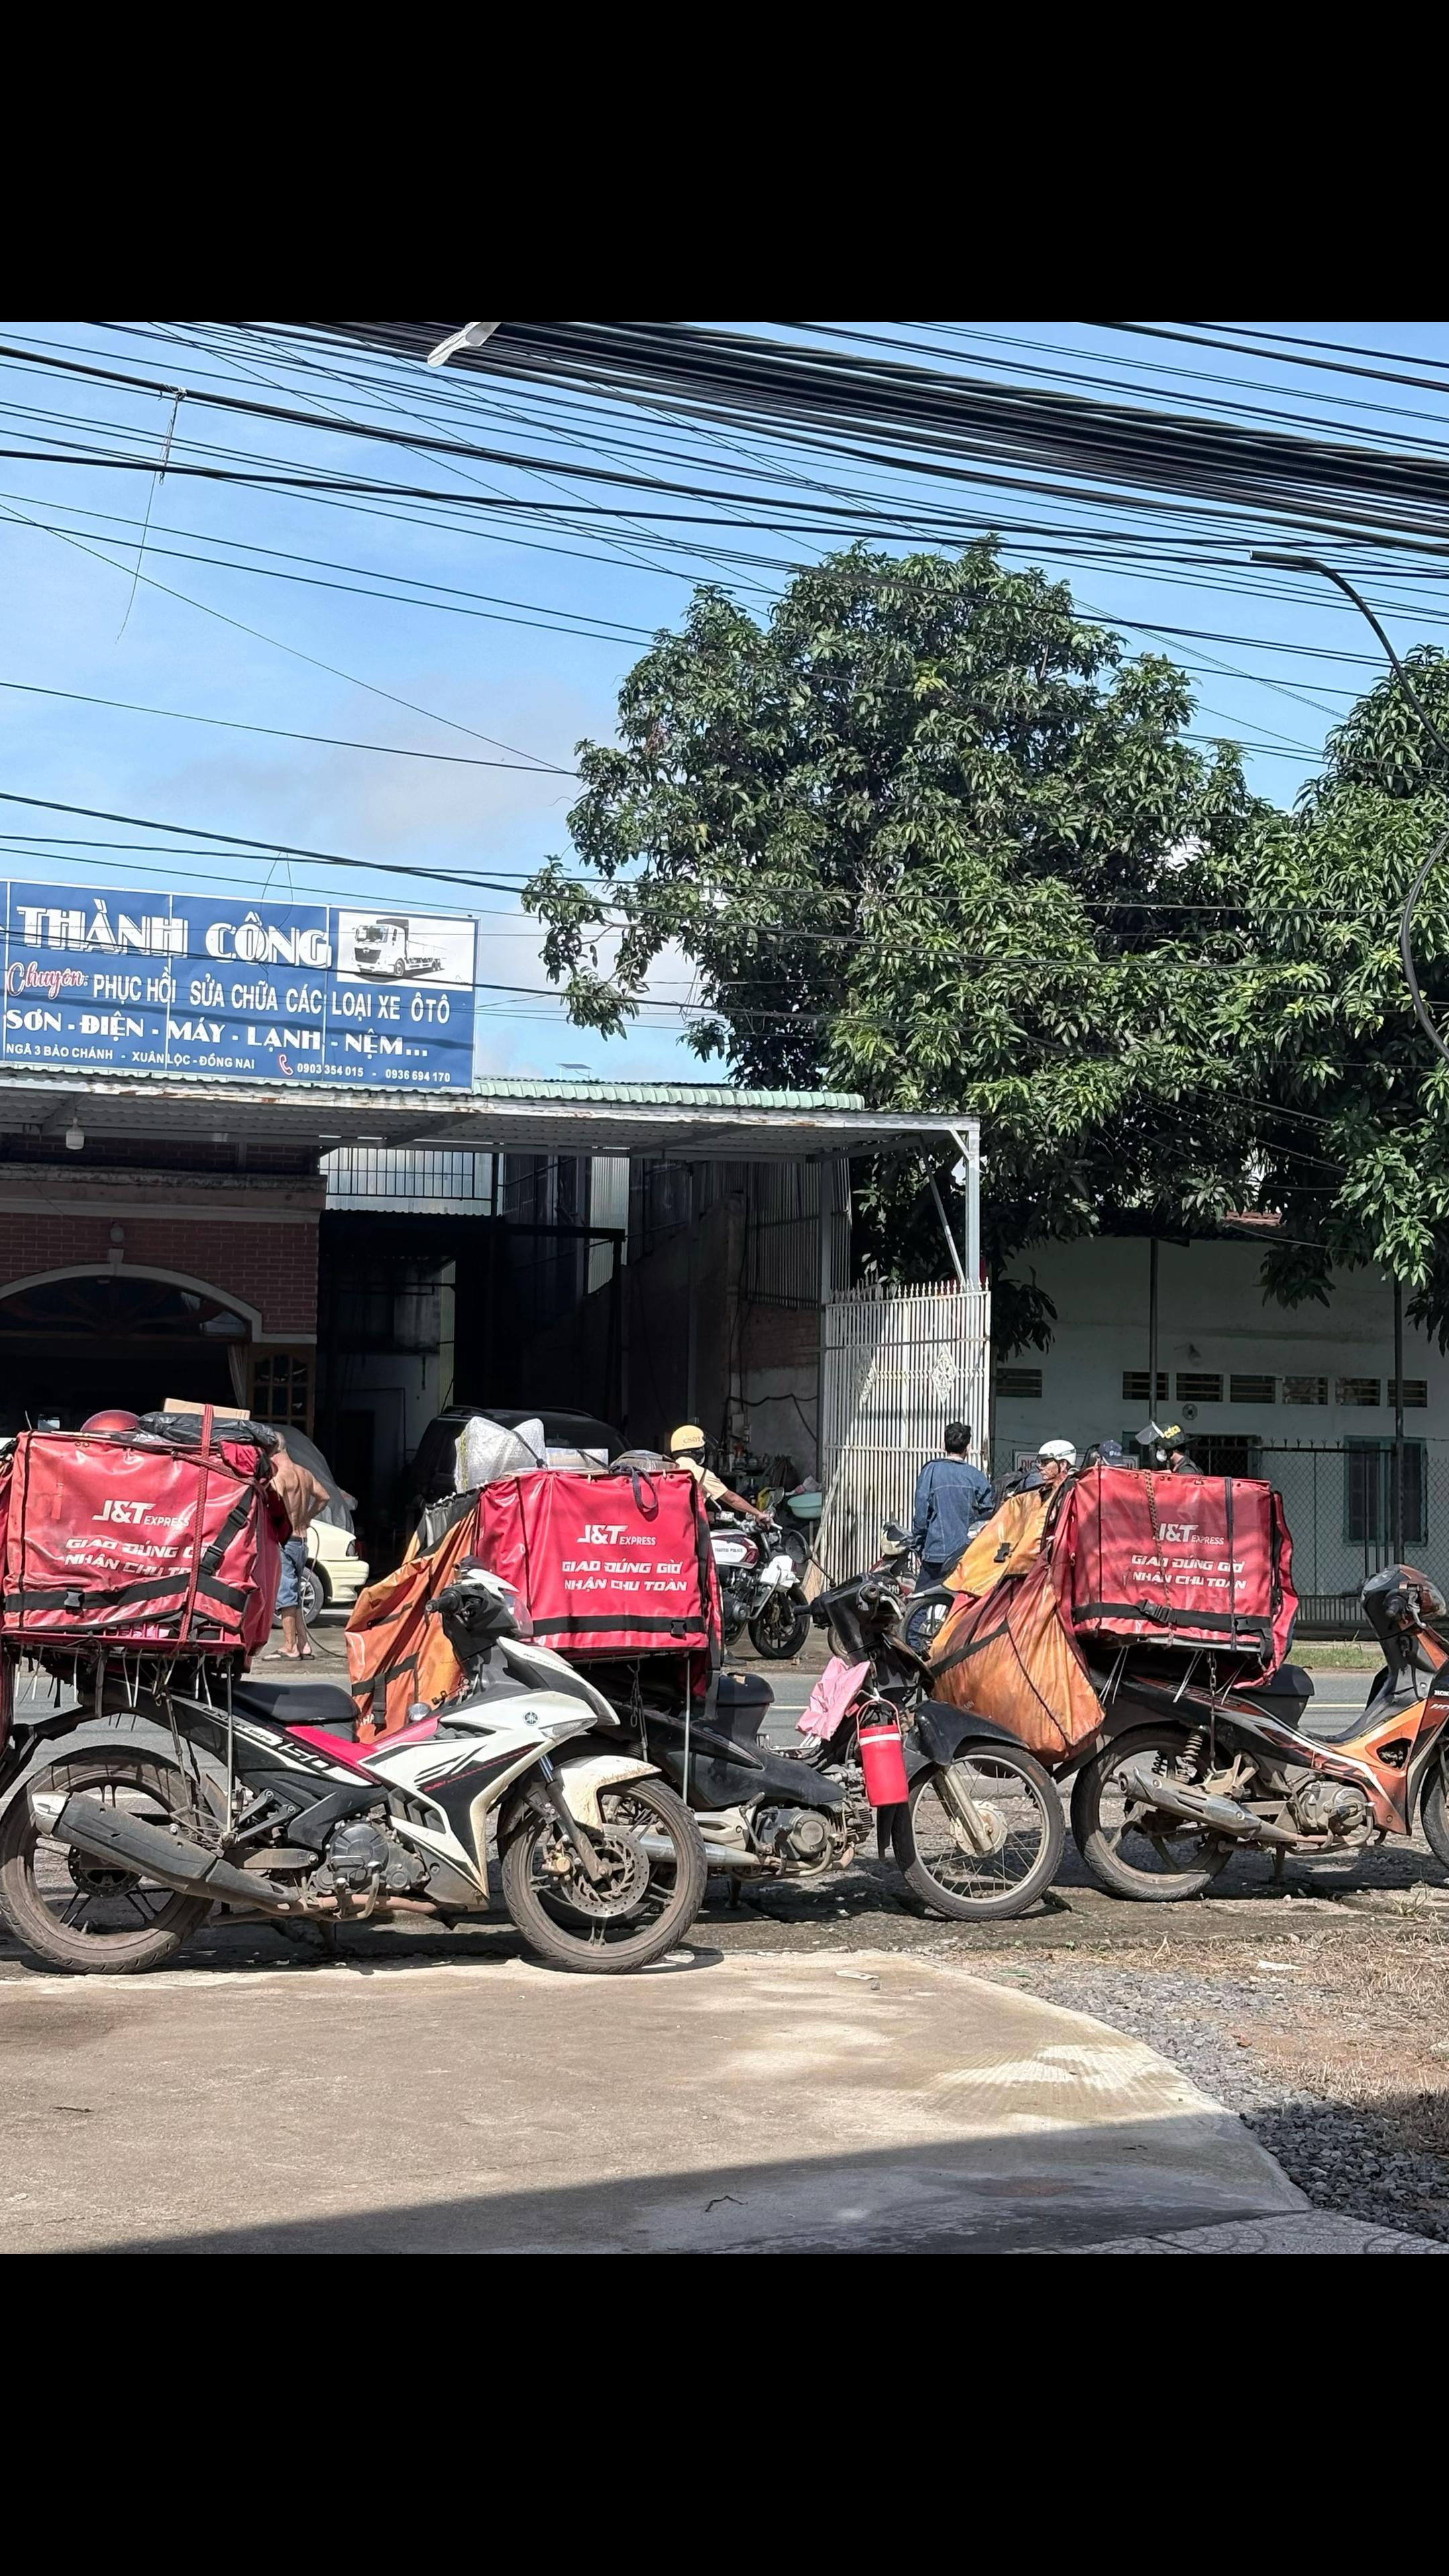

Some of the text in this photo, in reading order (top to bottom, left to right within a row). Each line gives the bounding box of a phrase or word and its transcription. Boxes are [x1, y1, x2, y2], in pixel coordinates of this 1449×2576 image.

[16, 898, 332, 969] THÀNH CÔNG
[93, 973, 142, 1004] PHỤC
[147, 966, 176, 1004] HỒI
[190, 973, 225, 1007] SỬA
[231, 980, 278, 1011] CHỮA
[286, 983, 322, 1014] CÁC
[332, 991, 372, 1022] LOẠI
[378, 995, 400, 1020] XE
[411, 991, 450, 1024] ÔTÔ
[6, 1008, 62, 1032] SƠN
[79, 1010, 144, 1042] ĐIỆN
[168, 1017, 225, 1042] MÁY
[248, 1026, 321, 1052] LẠNH
[34, 1045, 41, 1055] 3
[72, 1046, 113, 1059] CHÁNH
[131, 1051, 164, 1064] XUÂN
[235, 1058, 255, 1069] NAI
[297, 1063, 451, 1083] 0903 354 015 0936 694 170
[92, 1499, 189, 1526] J&T EXPRESS
[577, 1524, 656, 1546] J&T EXPRESS
[1152, 1523, 1224, 1545] J&T EXPRESS
[66, 1539, 117, 1550] GIAO
[121, 1540, 179, 1558] ĐÚNG
[562, 1558, 683, 1574] GIAO ĐÚNG GIỜ
[1172, 1555, 1214, 1571] ĐÚNG
[564, 1576, 607, 1592] NHẬN
[644, 1578, 687, 1591] TOÀN
